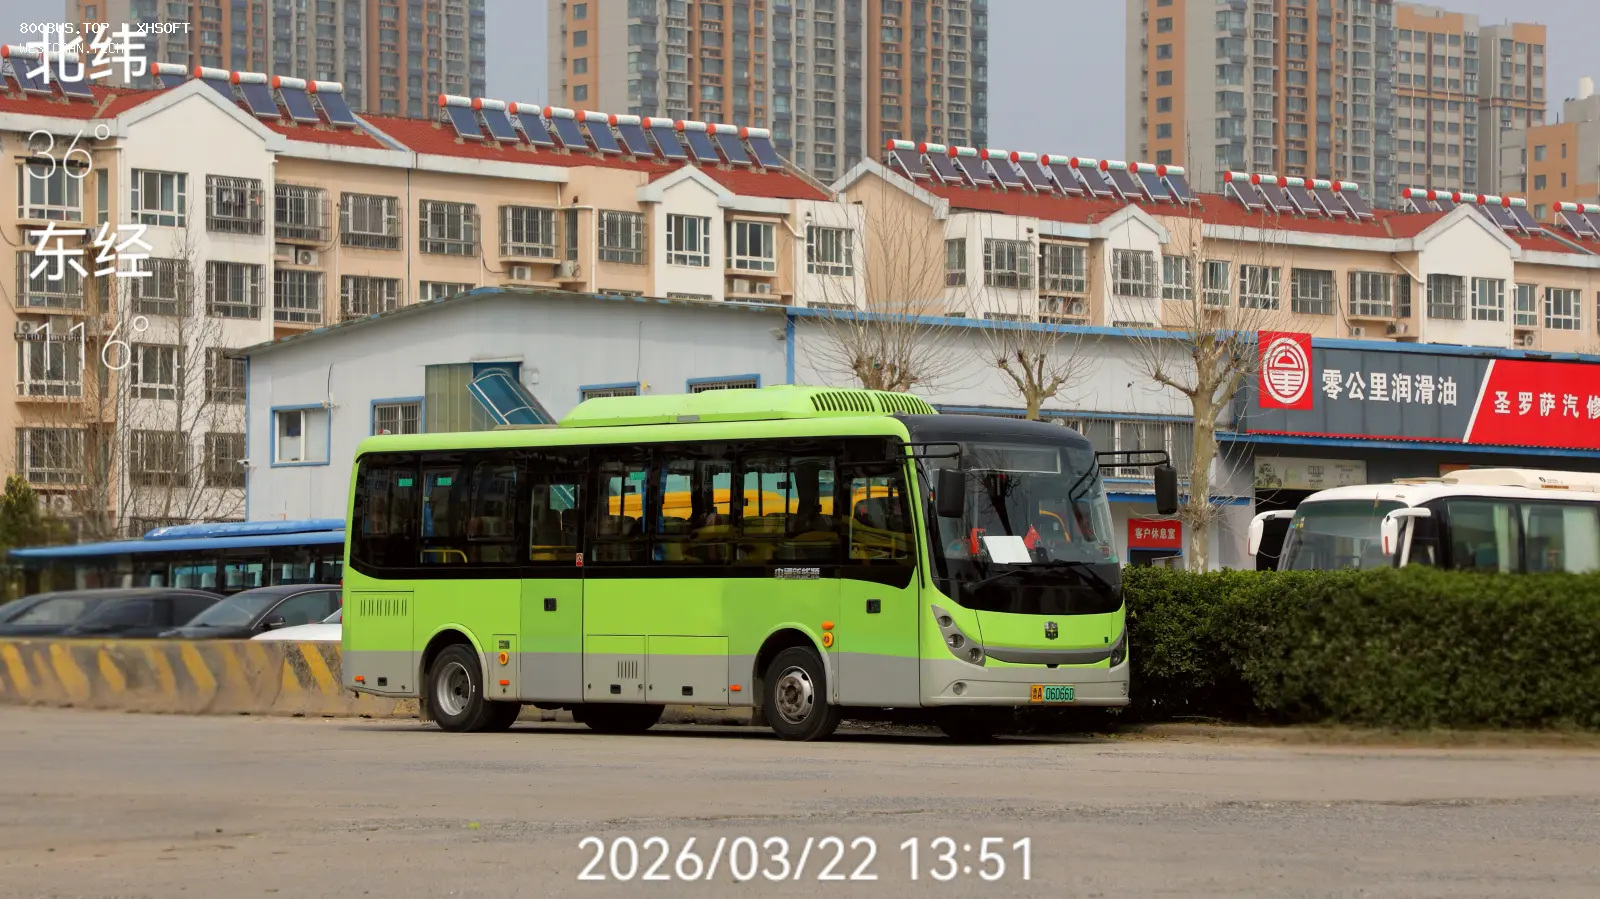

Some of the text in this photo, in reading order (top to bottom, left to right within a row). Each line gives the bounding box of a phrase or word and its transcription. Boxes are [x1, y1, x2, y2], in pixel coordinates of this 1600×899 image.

[1322, 368, 1457, 406] 零公里润滑油
[1494, 390, 1600, 420] 圣罗萨汽修
[1134, 527, 1176, 540] 客户休息室
